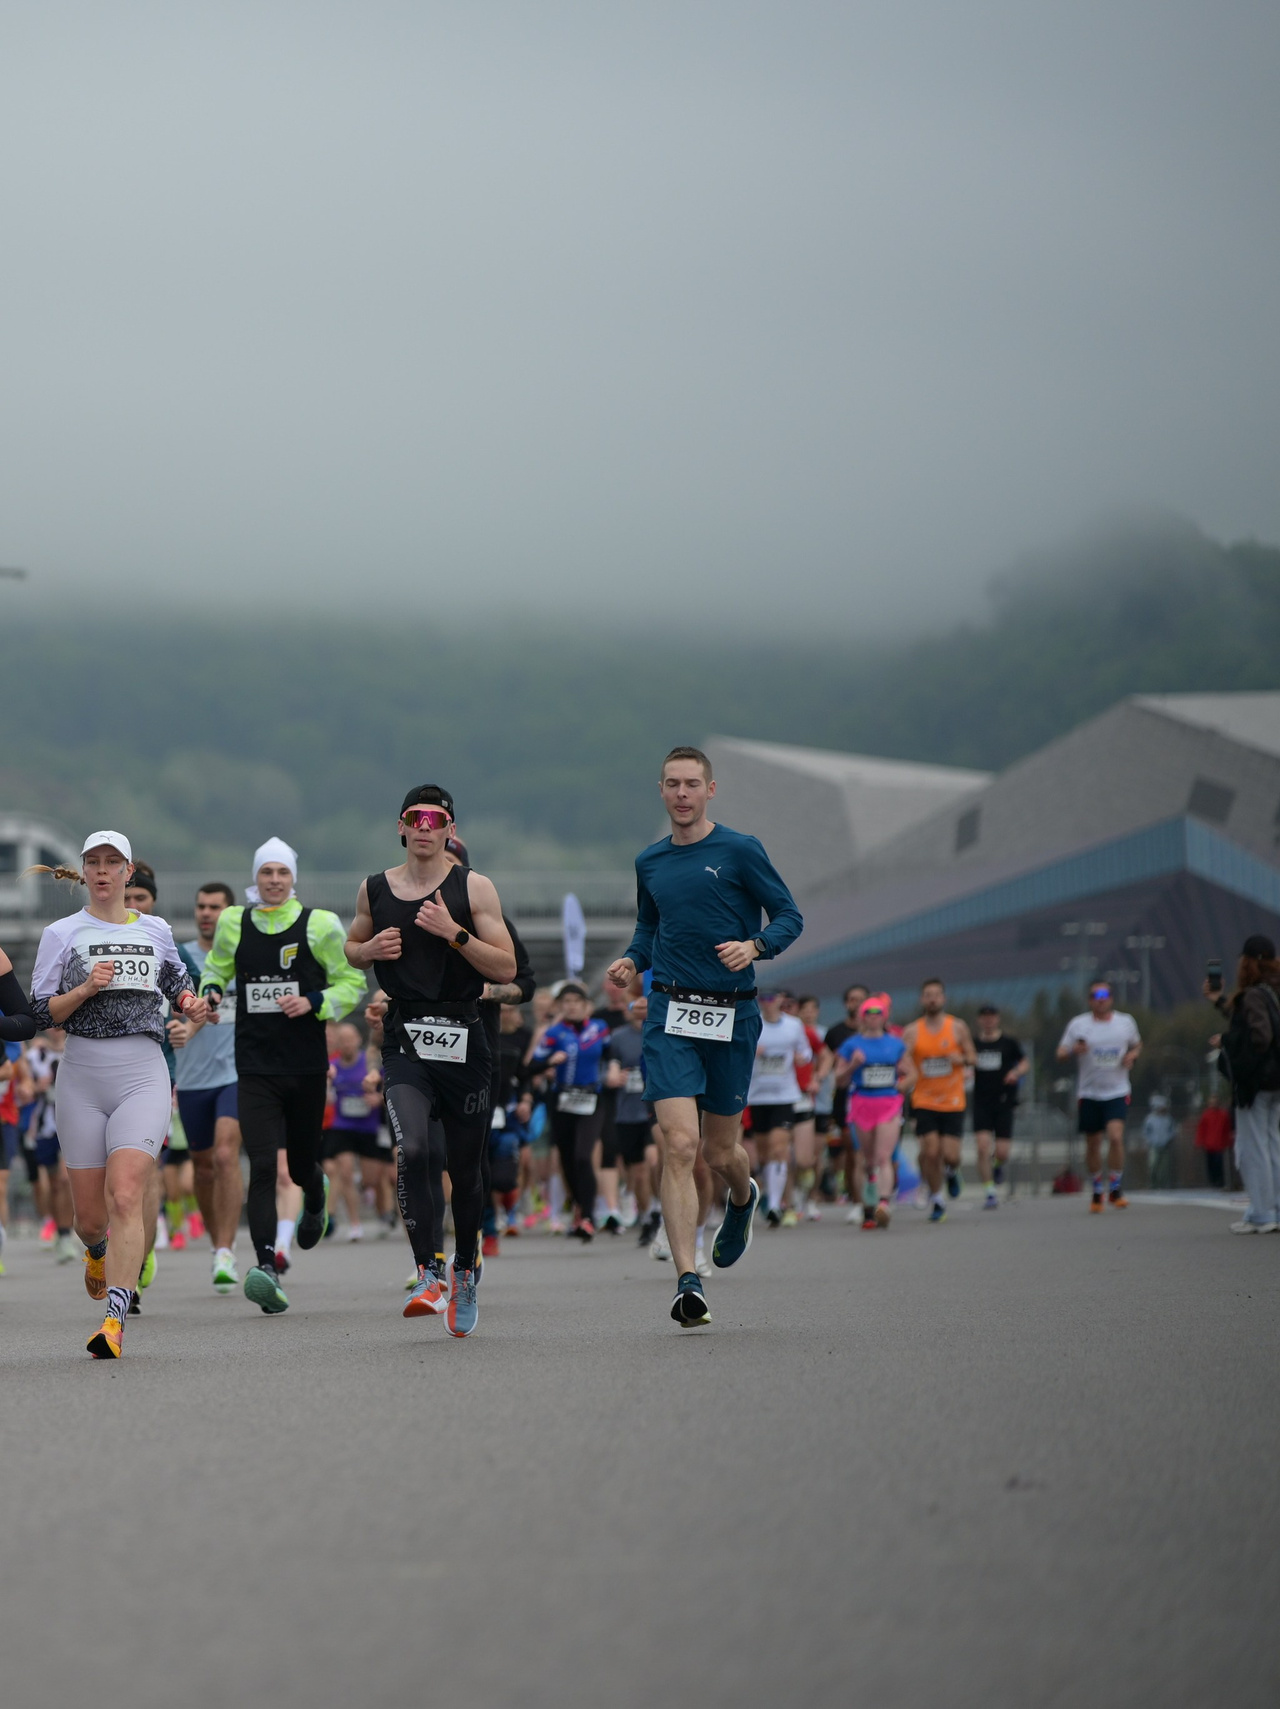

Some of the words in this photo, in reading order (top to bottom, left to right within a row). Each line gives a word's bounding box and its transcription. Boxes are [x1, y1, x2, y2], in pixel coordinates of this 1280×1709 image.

[98, 960, 149, 976] 830
[252, 985, 293, 1001] 6466
[676, 1007, 728, 1027] 7867
[410, 1029, 461, 1048] 7847
[386, 1099, 404, 1142] VENUM
